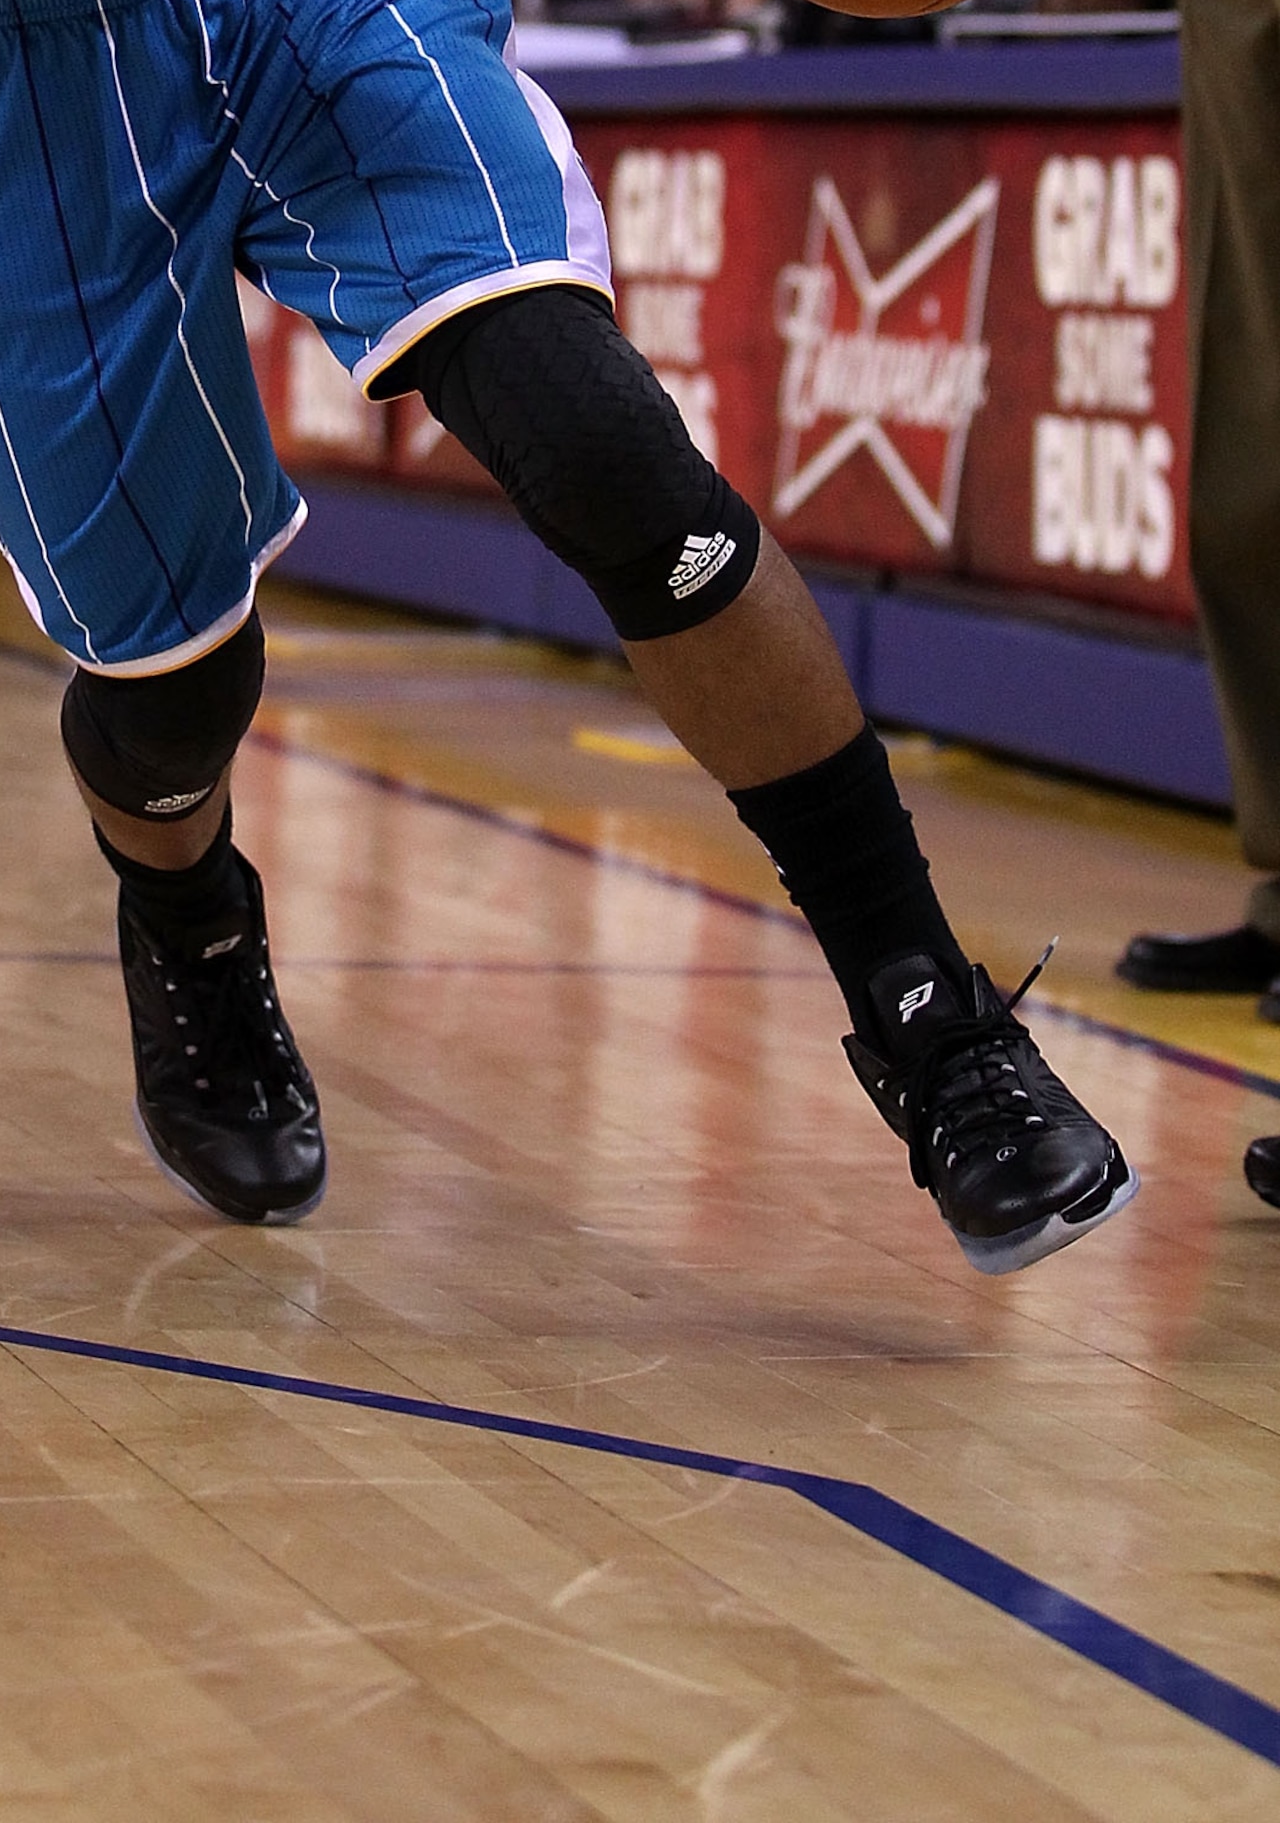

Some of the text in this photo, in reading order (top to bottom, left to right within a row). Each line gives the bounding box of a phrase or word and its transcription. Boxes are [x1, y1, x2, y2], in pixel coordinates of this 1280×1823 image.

[1033, 153, 1182, 308] GRAB
[667, 531, 726, 587] adidas
[1030, 412, 1176, 581] BUDS
